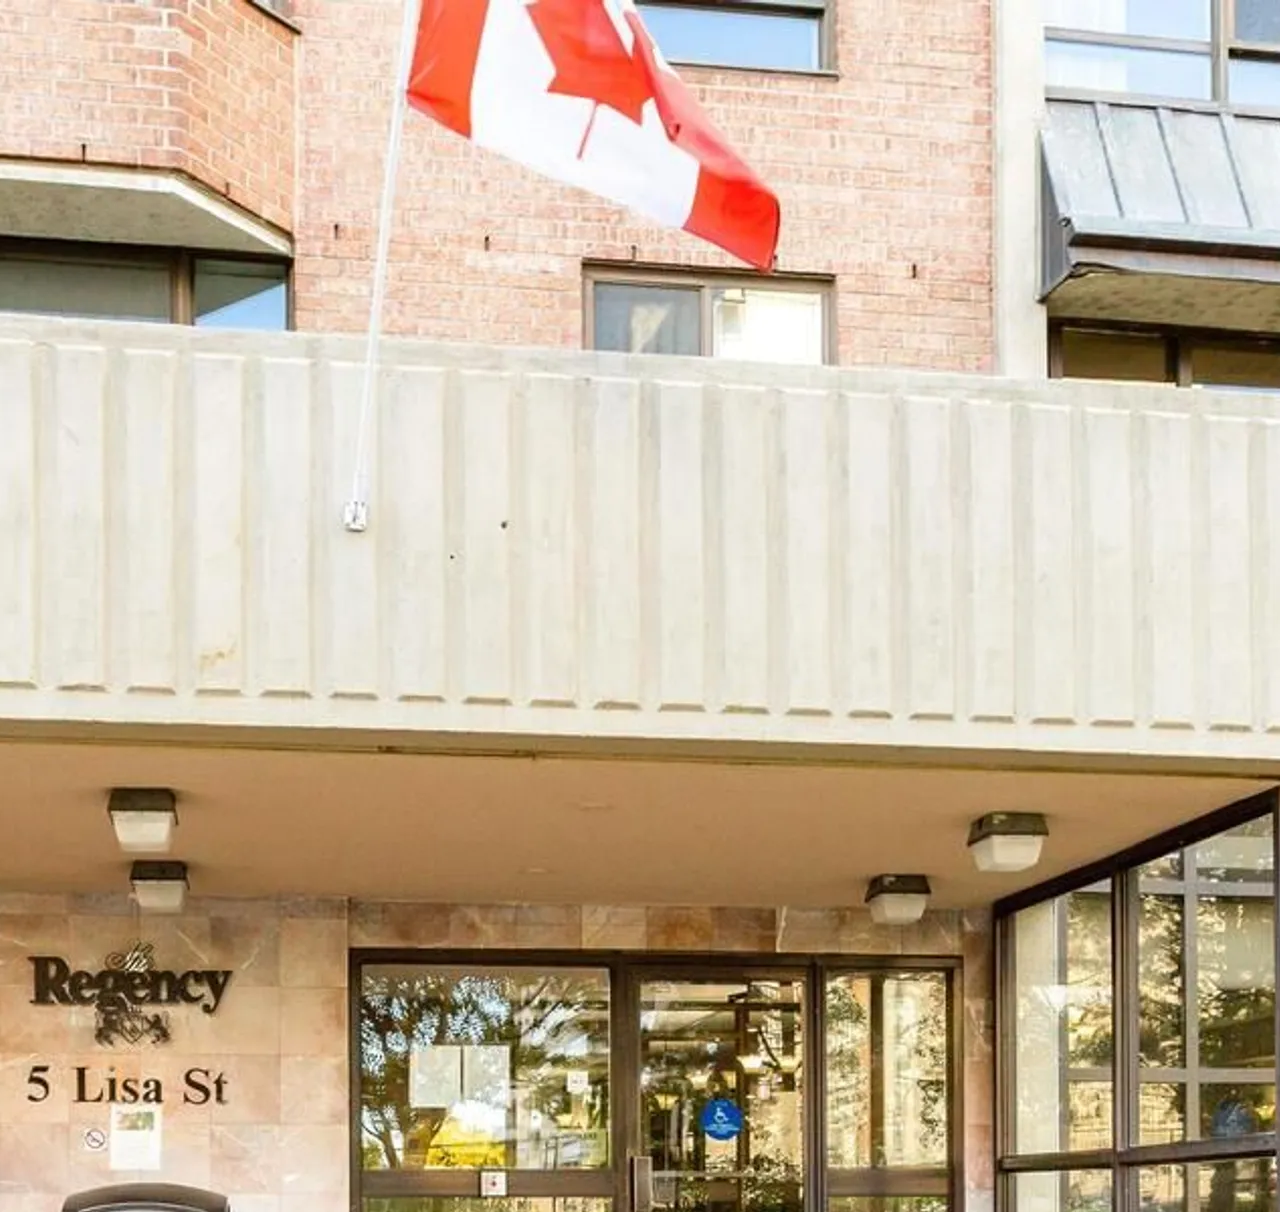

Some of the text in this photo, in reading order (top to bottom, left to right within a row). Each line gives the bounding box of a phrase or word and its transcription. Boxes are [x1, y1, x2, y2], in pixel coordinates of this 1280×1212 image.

[28, 956, 233, 1014] Regency
[28, 1066, 228, 1105] 5 Lisa St
